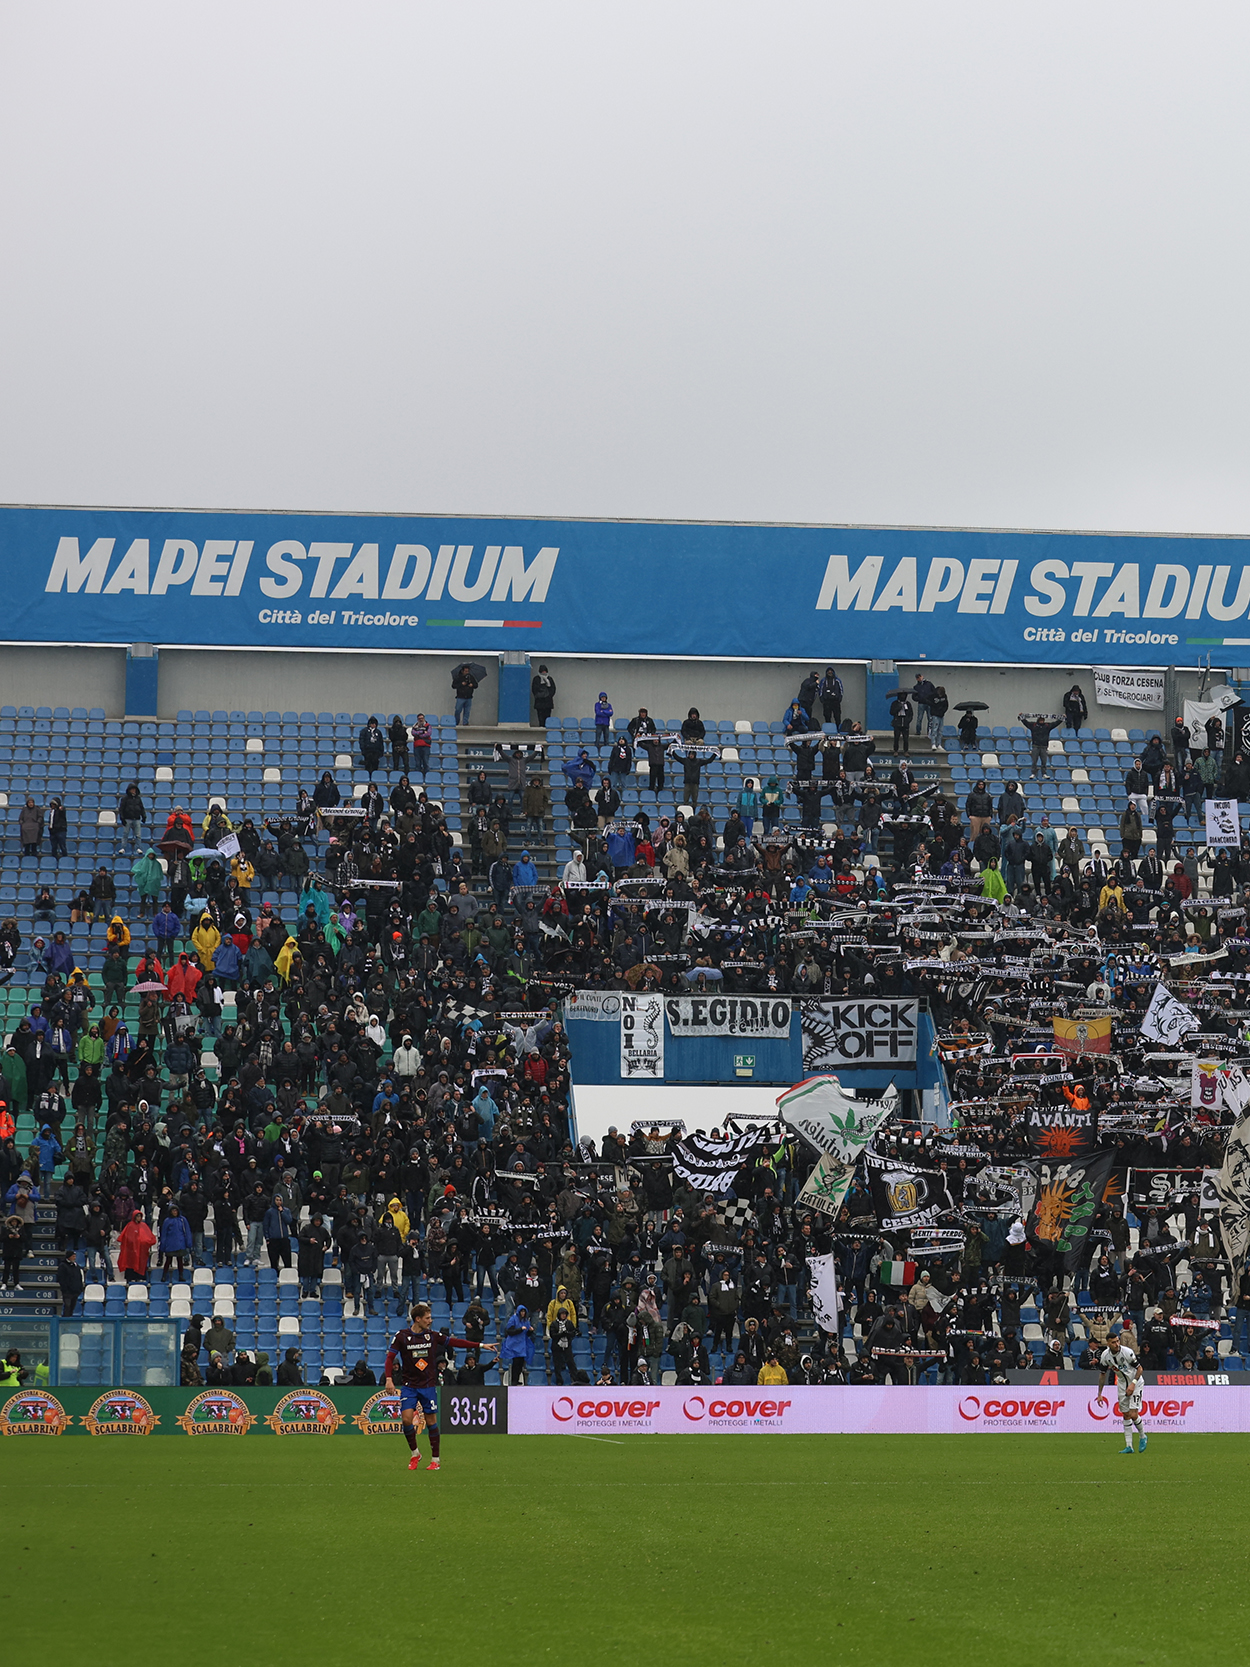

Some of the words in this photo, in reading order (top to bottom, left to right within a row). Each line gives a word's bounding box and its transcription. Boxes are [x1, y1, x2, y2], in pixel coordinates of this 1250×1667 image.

[45, 537, 254, 596] MAPEI
[259, 540, 560, 602] STADIUM
[816, 555, 1019, 614] MAPEI
[258, 609, 302, 625] Città
[307, 610, 335, 625] del
[341, 611, 418, 627] Tricolore
[1023, 627, 1065, 642] Città
[1071, 628, 1098, 643] del
[1103, 629, 1178, 645] Tricolore
[1093, 671, 1111, 684] CLUB
[1112, 674, 1135, 687] FORZA
[1136, 677, 1164, 689] CESENA
[668, 996, 790, 1030] S.EGIDIO
[831, 1003, 916, 1029] KICK
[627, 1049, 658, 1058] BELLARIA
[838, 1030, 917, 1059] OFF
[1030, 1111, 1092, 1127] AVANTI
[801, 1191, 840, 1215] GATULEN
[881, 1203, 942, 1229] CESENA
[1157, 1374, 1206, 1386] ENERGIA
[1207, 1375, 1230, 1386] PER
[450, 1397, 496, 1426] 33:51
[577, 1400, 660, 1418] cover
[708, 1400, 791, 1417] cover
[983, 1400, 1065, 1418] cover
[6, 1422, 60, 1436] SCALABRINI
[94, 1422, 147, 1436] SCALABRINI
[191, 1422, 243, 1436] SCALABRINI
[280, 1422, 332, 1435] SCALABRINI
[708, 1419, 749, 1427] PROTEGGE
[754, 1419, 783, 1427] METALLI
[983, 1419, 1022, 1427] PROTEGGE
[1028, 1419, 1056, 1427] METALLI
